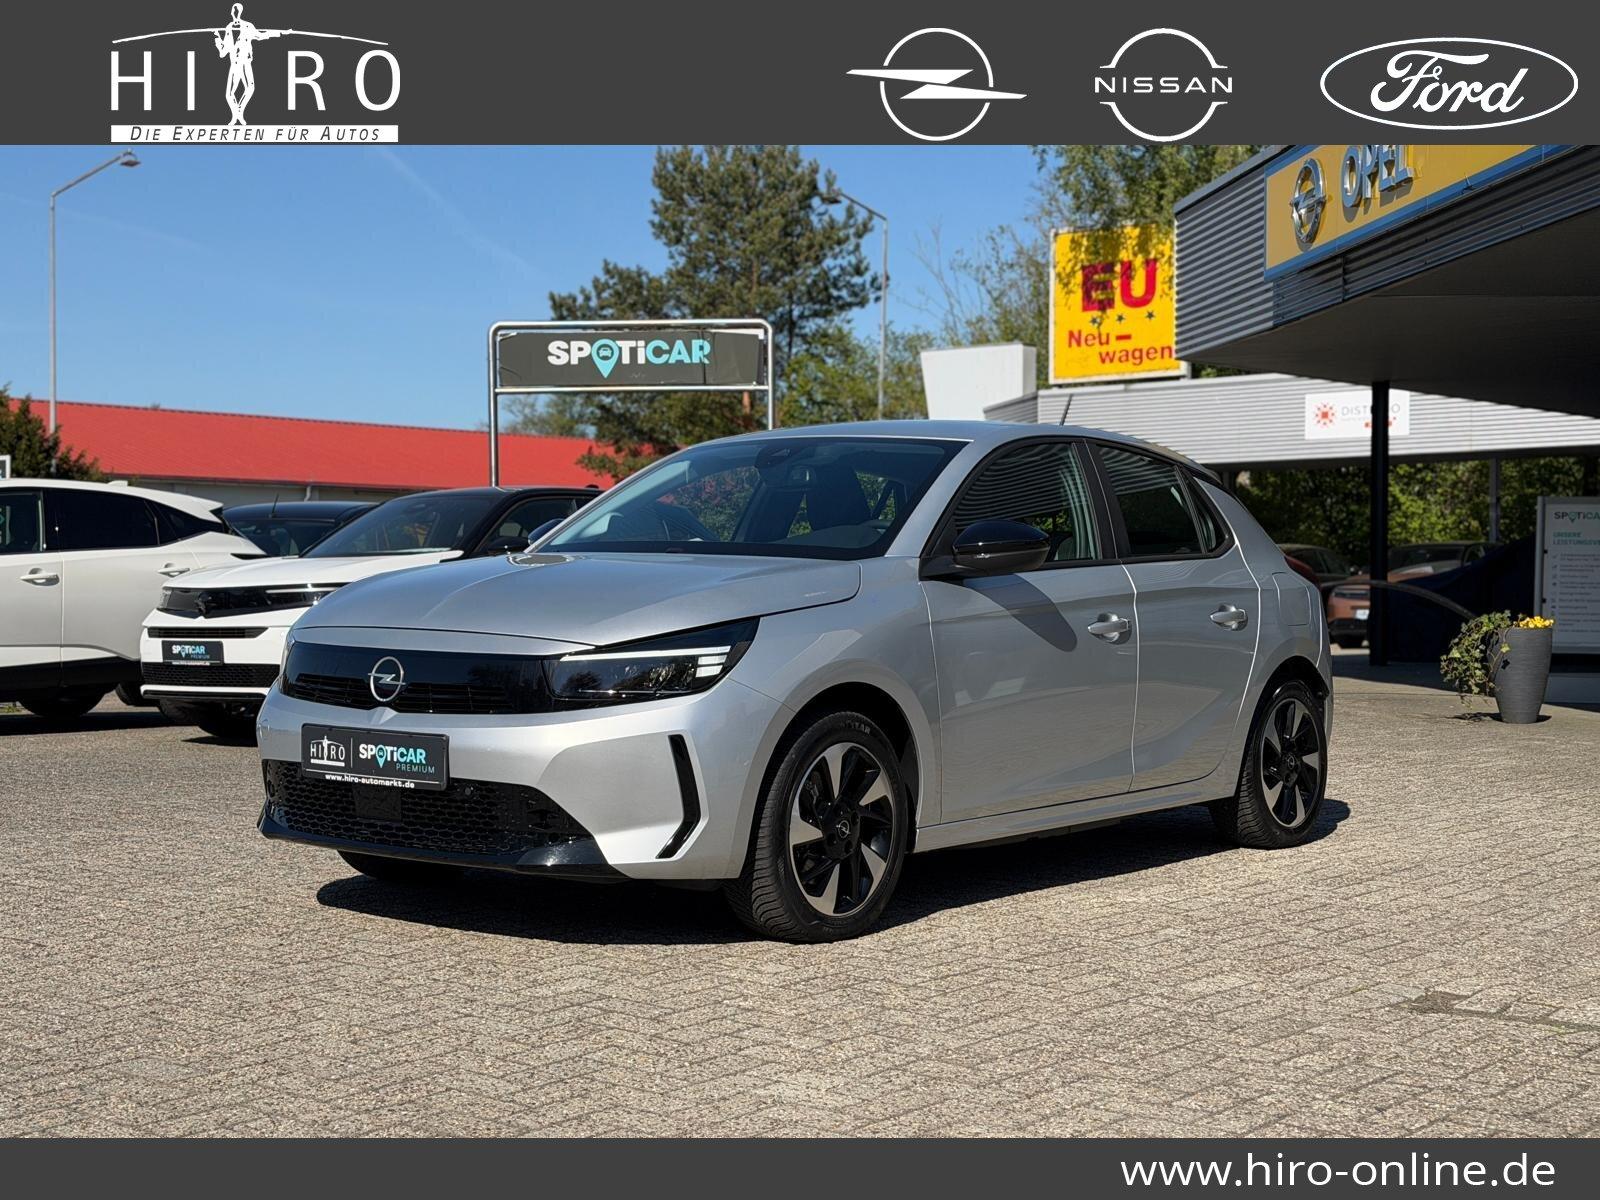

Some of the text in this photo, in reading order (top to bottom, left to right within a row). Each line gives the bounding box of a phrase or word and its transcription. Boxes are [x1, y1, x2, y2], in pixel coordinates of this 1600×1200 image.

[1341, 145, 1413, 207] OPEL
[1081, 258, 1157, 312] EU
[1099, 345, 1173, 365] wagen
[310, 743, 345, 760] HIRO
[396, 762, 435, 774] PREMIUM
[325, 773, 415, 789] www.hiro-automarkt.de
